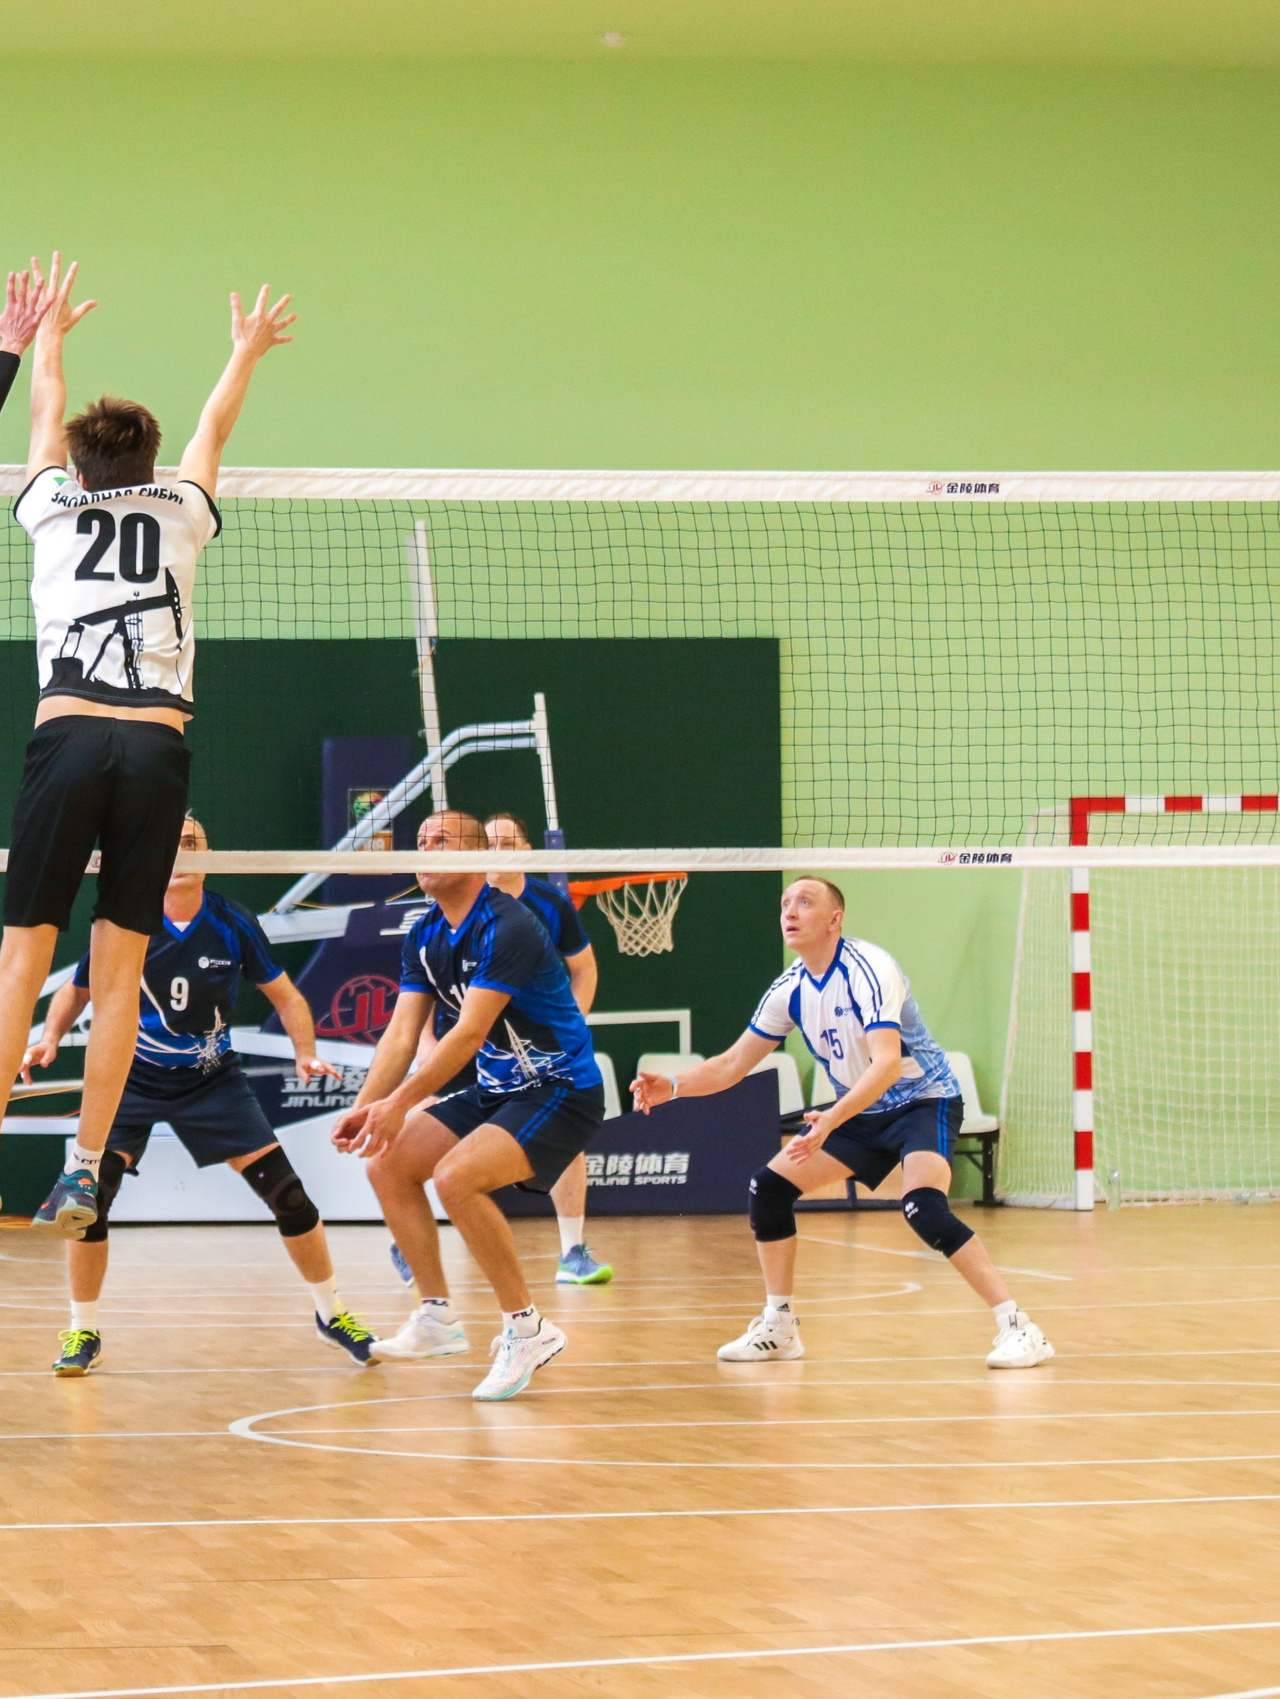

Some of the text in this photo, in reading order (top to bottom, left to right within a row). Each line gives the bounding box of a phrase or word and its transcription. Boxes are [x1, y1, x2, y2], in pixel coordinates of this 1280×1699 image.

[946, 482, 1000, 494] 金陵体育
[75, 508, 160, 584] 20
[959, 852, 1013, 864] 金陵体育
[170, 976, 190, 1012] 9
[820, 1028, 845, 1060] 15
[585, 1152, 690, 1176] 金陵体育
[634, 1175, 688, 1185] SPORTS
